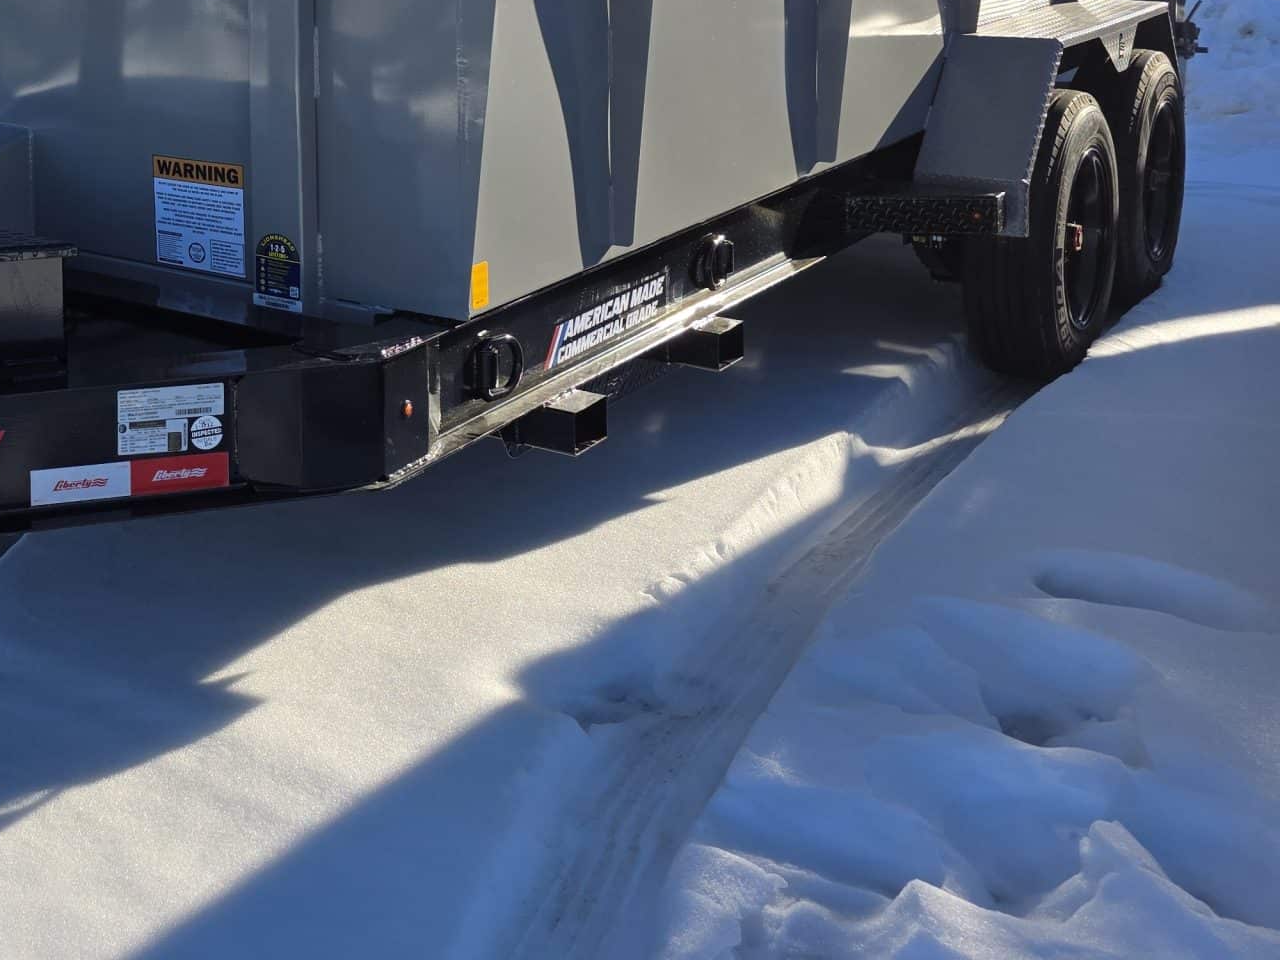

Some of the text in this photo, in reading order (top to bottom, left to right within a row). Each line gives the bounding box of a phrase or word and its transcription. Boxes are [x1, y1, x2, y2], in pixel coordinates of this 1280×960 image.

[157, 159, 239, 184] WARNING
[564, 275, 666, 340] AMERICAN MADE
[557, 300, 659, 364] COMMERCIAL GRADE
[53, 478, 94, 492] Liberty
